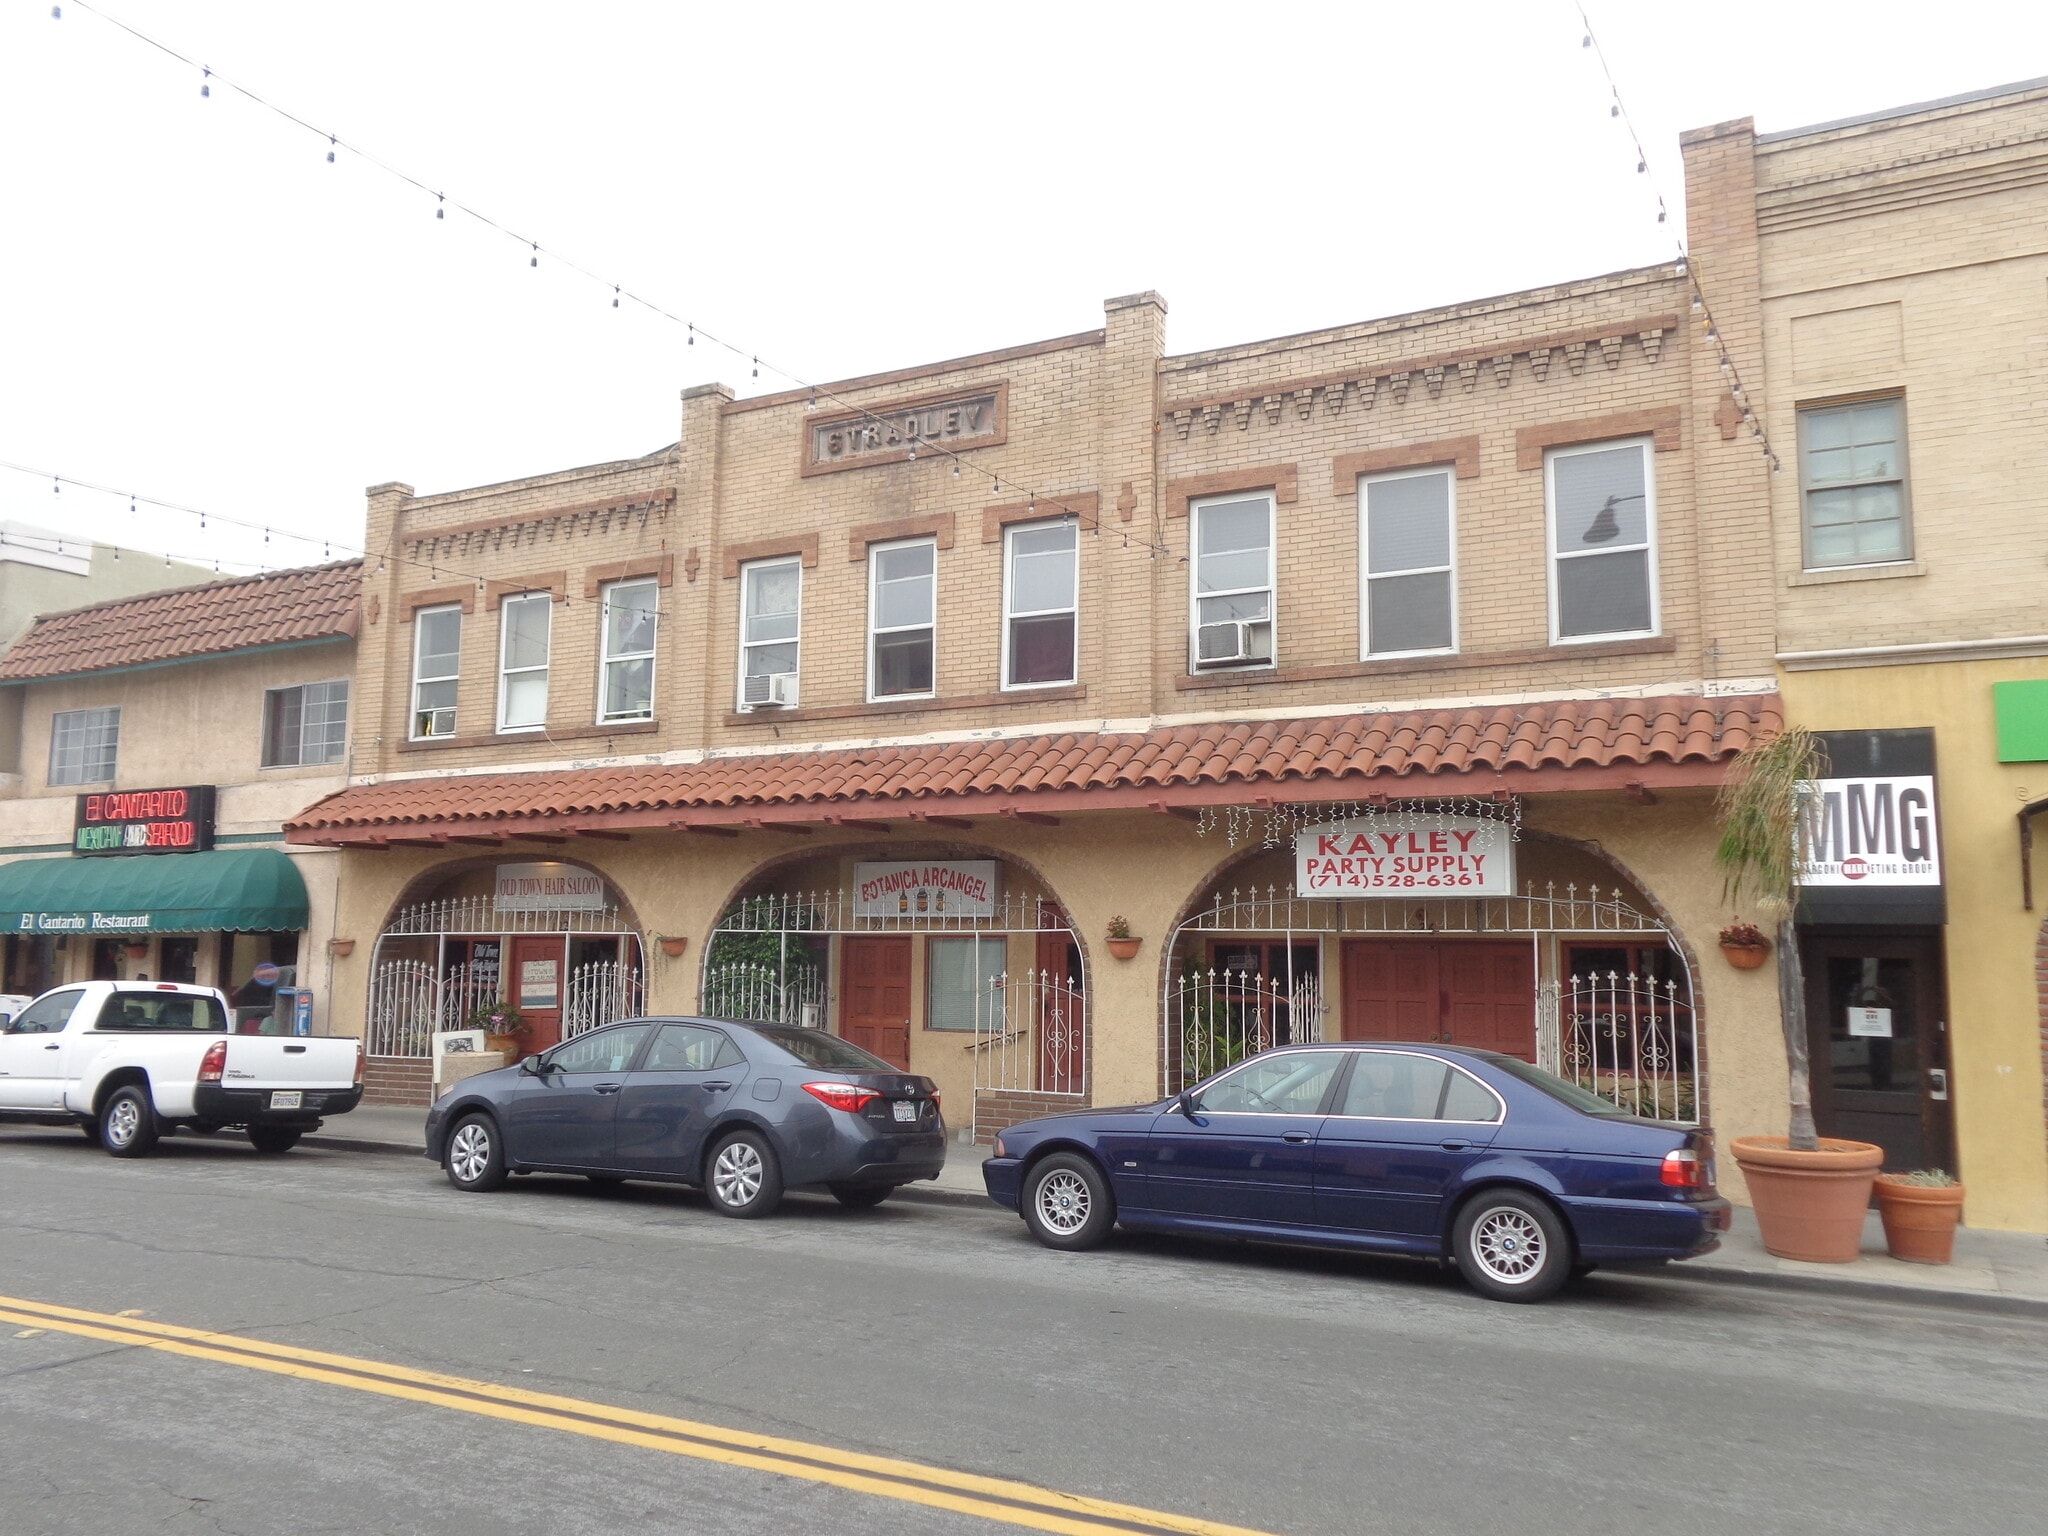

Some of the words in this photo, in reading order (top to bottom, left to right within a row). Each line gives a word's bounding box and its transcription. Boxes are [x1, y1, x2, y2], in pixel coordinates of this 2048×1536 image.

[86, 795, 102, 821] EL
[104, 789, 187, 820] CANTARITO
[1796, 783, 1931, 863] MMG
[76, 825, 122, 849] MEXICAN
[123, 824, 146, 848] AND
[146, 822, 194, 847] SEAFOOD
[1318, 830, 1477, 856] KAYLEY
[1307, 857, 1385, 874] PARTY
[1393, 855, 1486, 874] SUPPLY
[1902, 863, 1933, 874] GROUP
[500, 878, 517, 896] OLD
[518, 878, 542, 896] TOWN
[544, 877, 565, 895] HAIR
[567, 876, 602, 895] SALOON
[861, 868, 919, 902] BOTANICA
[922, 867, 987, 902] ARCANGEL
[1309, 873, 1485, 889] (714)528-6361
[19, 913, 33, 929] El
[38, 912, 86, 929] Cantarito
[91, 912, 150, 929] Restaurant
